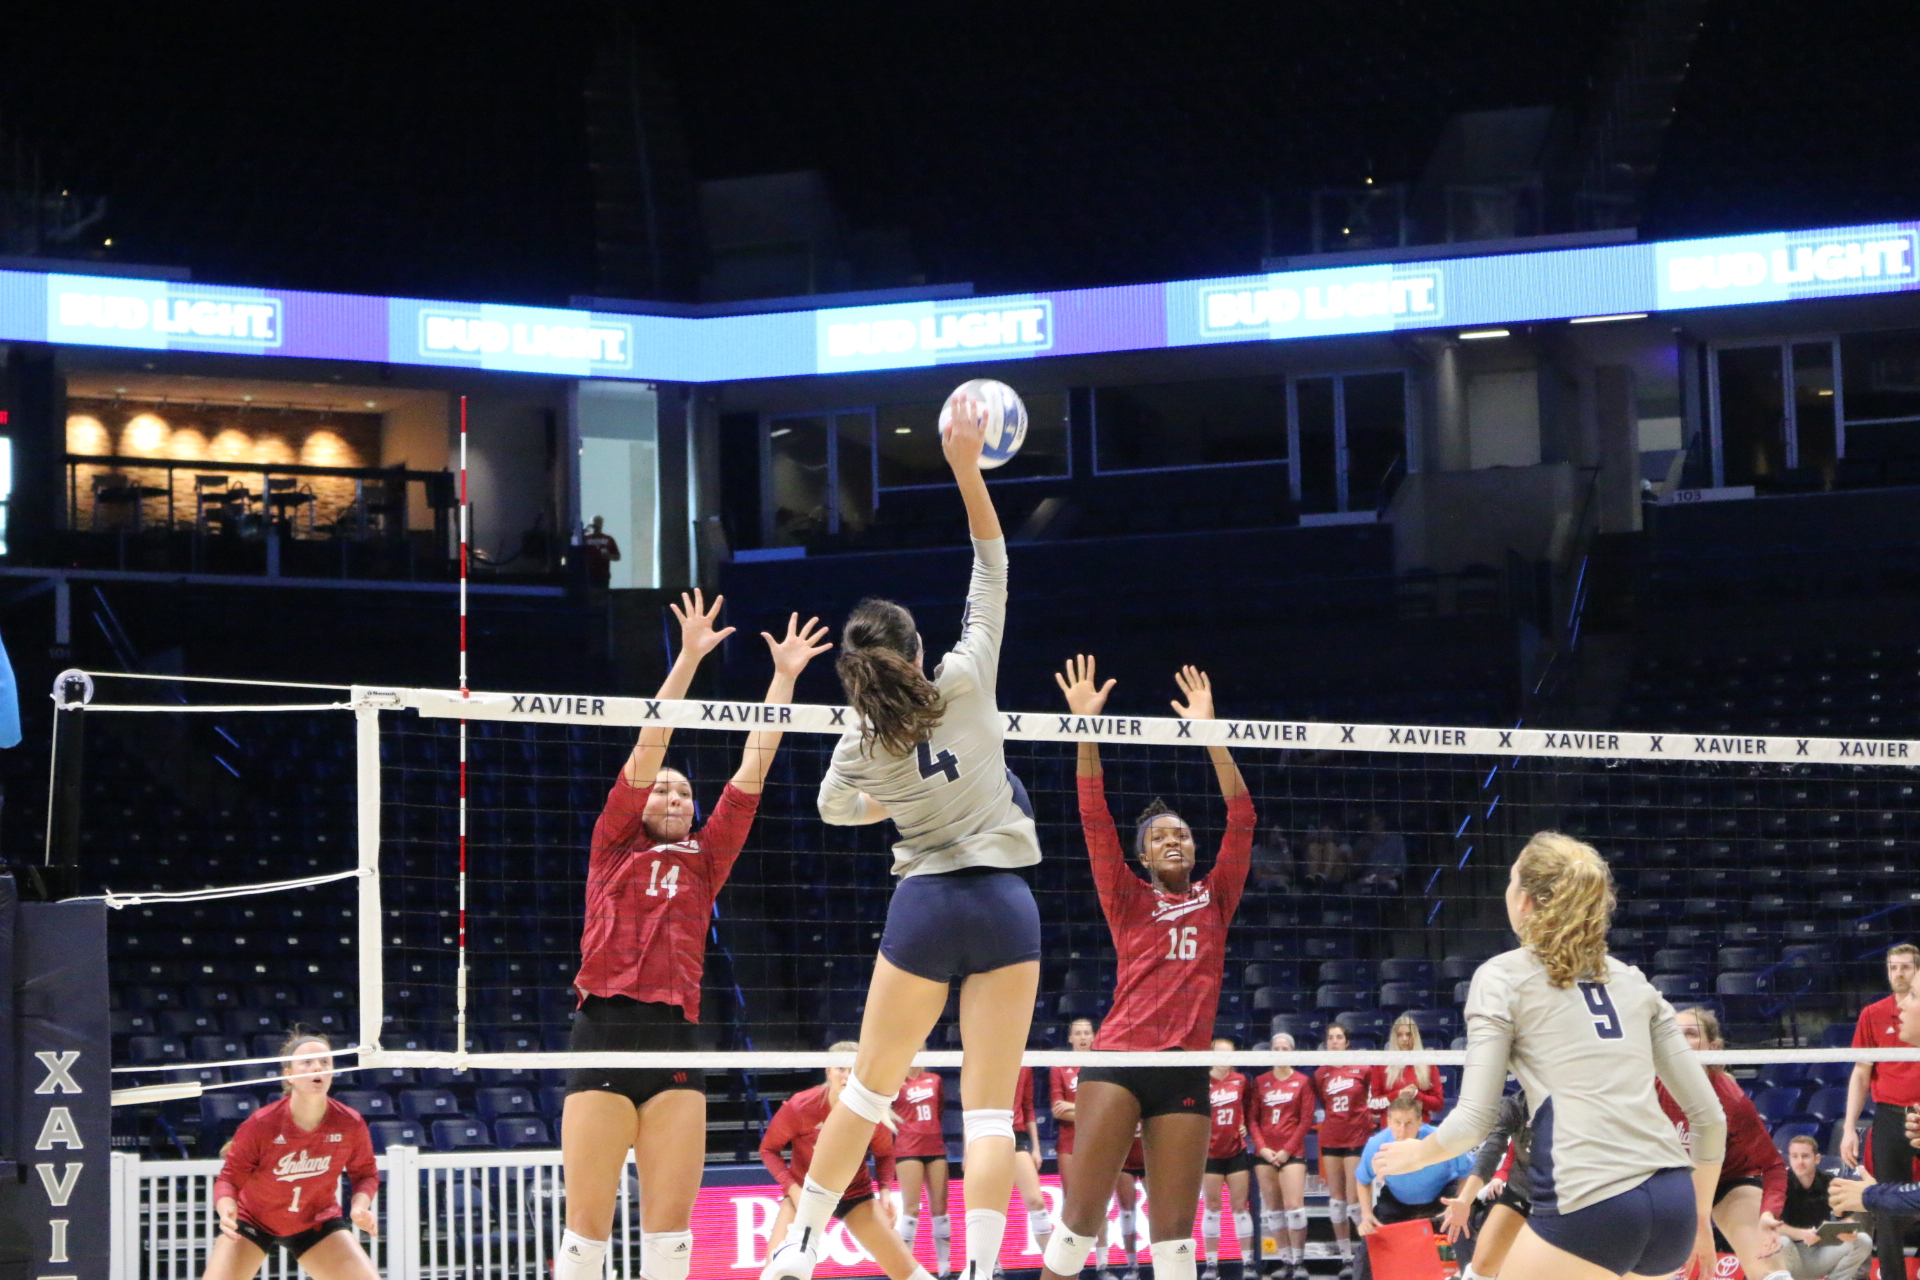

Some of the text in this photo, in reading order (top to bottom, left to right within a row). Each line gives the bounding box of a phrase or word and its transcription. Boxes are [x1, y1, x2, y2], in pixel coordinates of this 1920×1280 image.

[1668, 251, 1768, 292] BUD
[59, 293, 149, 330] BUD
[1208, 289, 1300, 327] BUD
[426, 316, 511, 353] BUD
[827, 319, 917, 357] BUD
[511, 695, 1909, 758] XAVIER X XAVIER X X XAVIER X XAVIER X XAVIER X XAVIER X XAVIER X XAVIER
[916, 742, 961, 783] 4
[646, 860, 680, 898] 14
[1164, 926, 1198, 960] 16
[1576, 981, 1624, 1039] 9
[916, 1105, 932, 1121] 18
[1217, 1108, 1234, 1125] 27
[1271, 1109, 1281, 1125] 8
[1332, 1096, 1350, 1113] 22
[35, 1051, 83, 1280] XAVI
[273, 1150, 331, 1176] Indiana
[288, 1186, 302, 1213] 1
